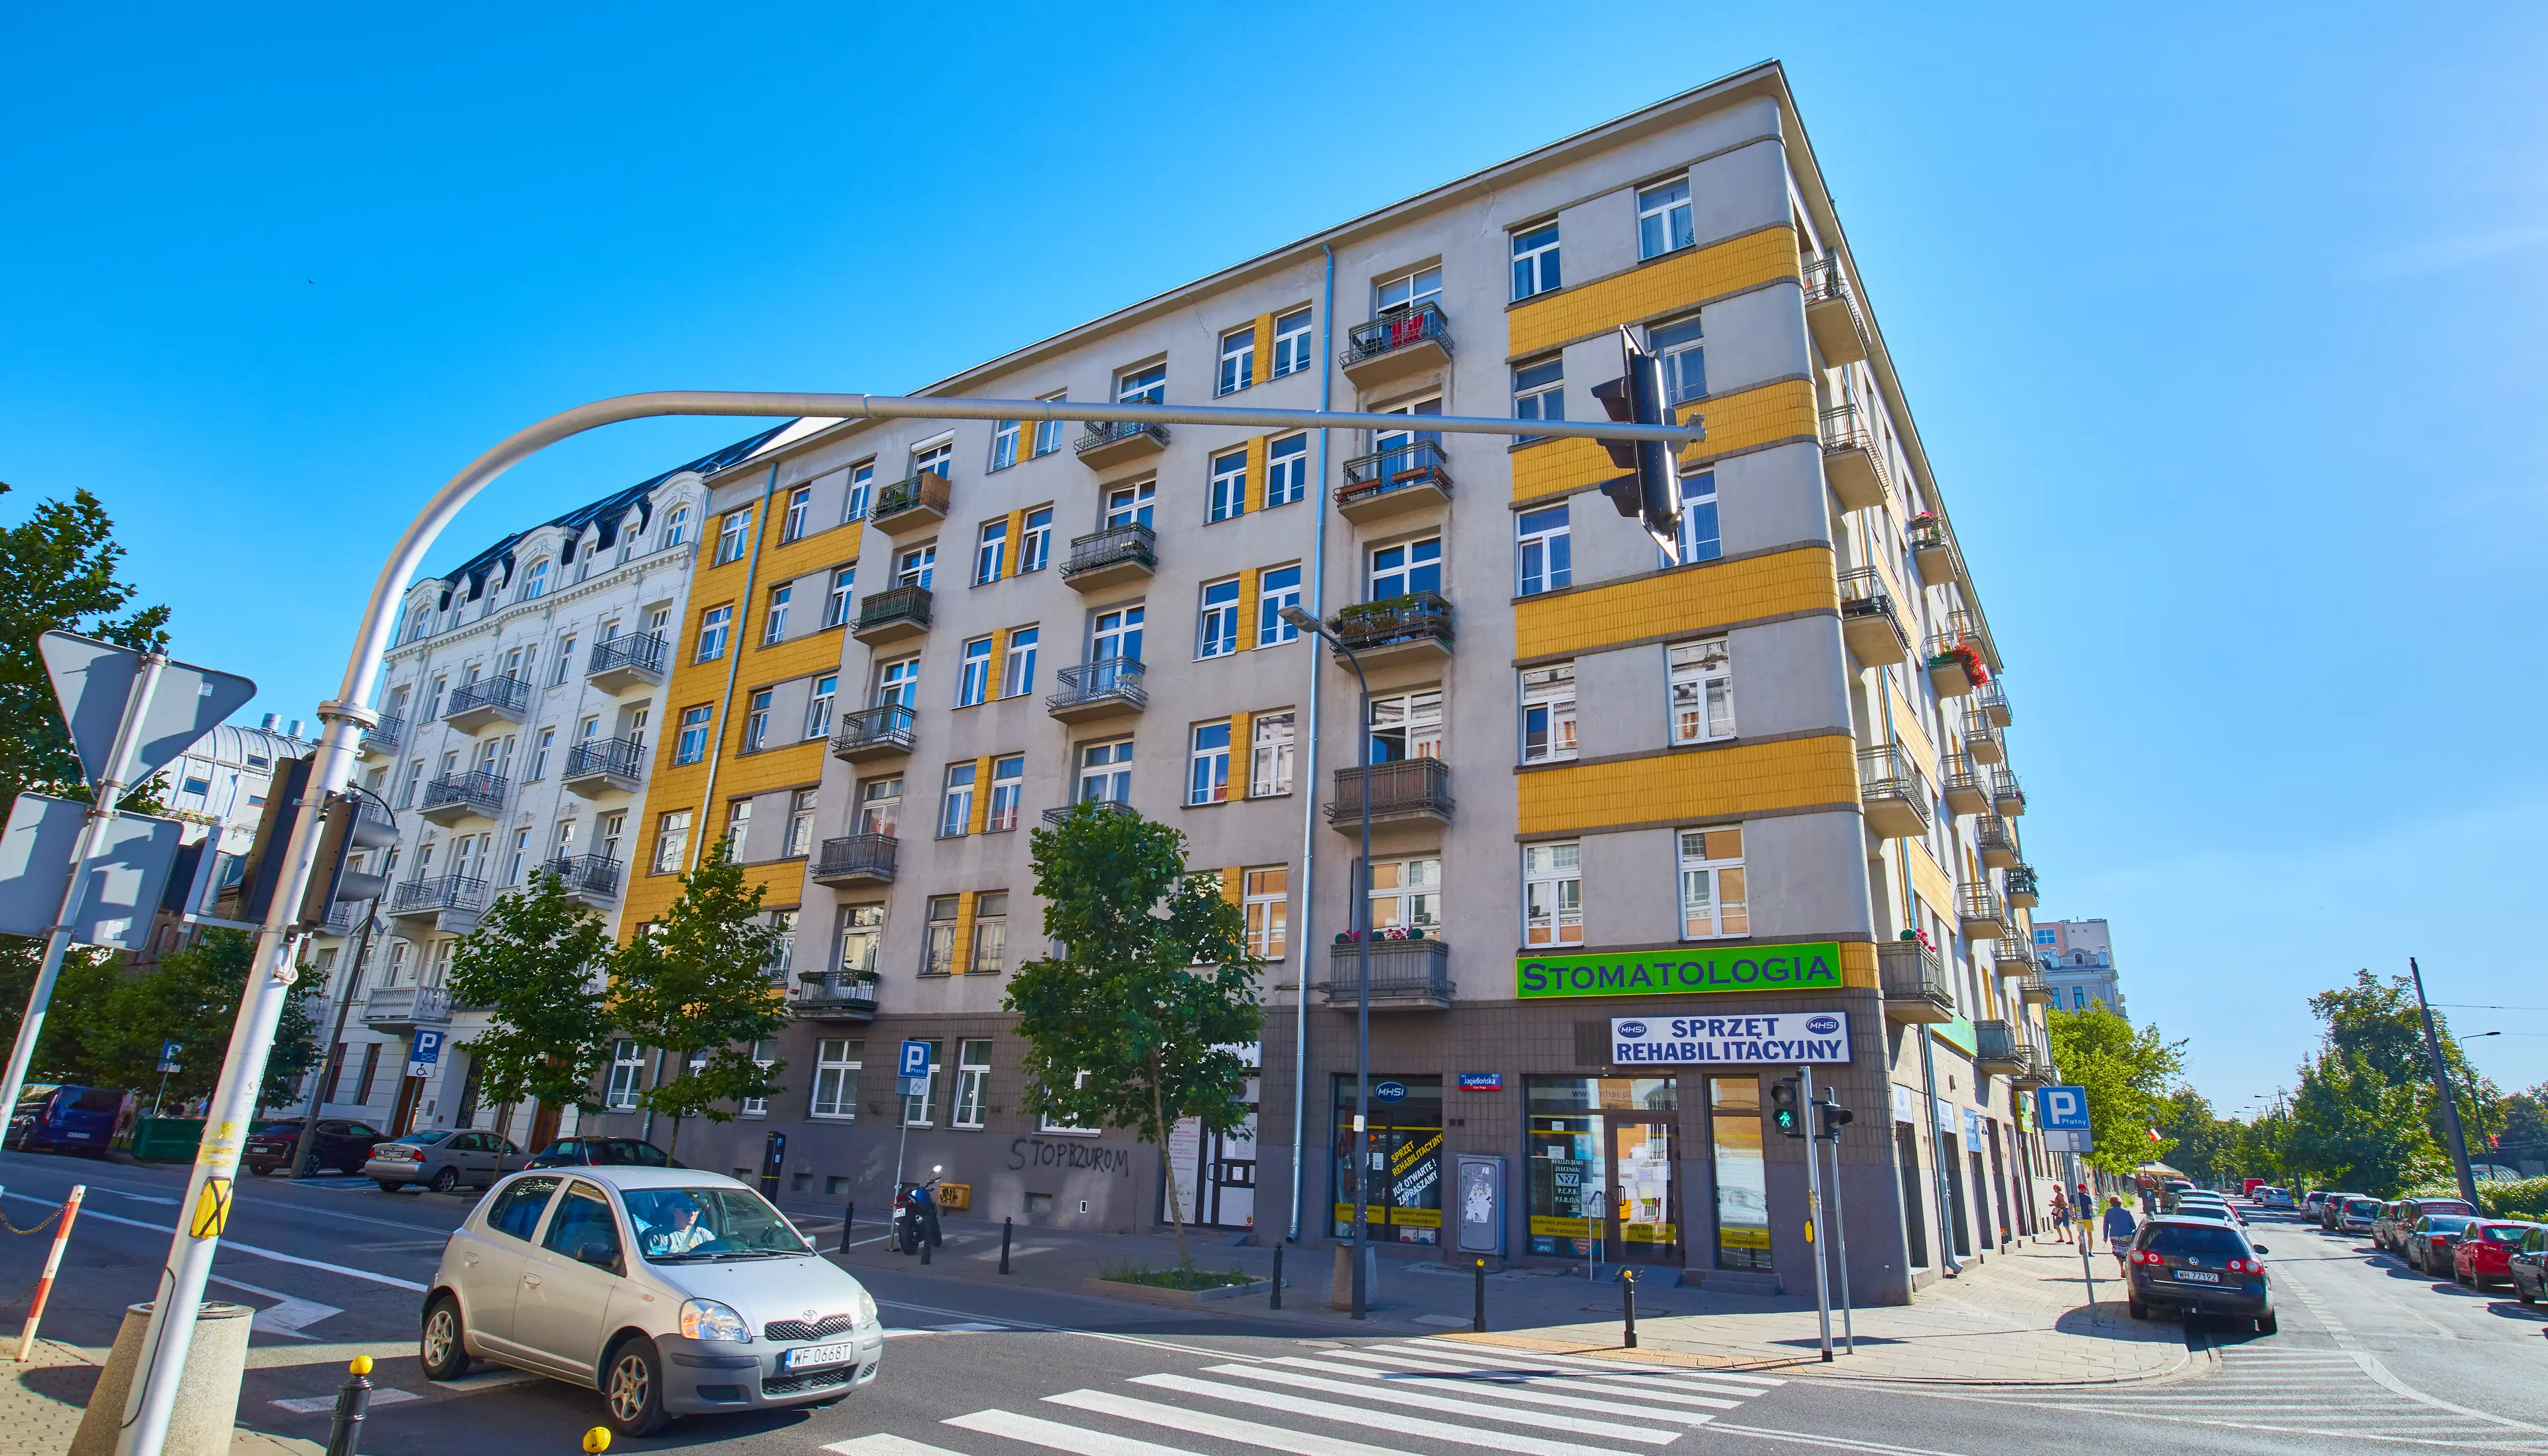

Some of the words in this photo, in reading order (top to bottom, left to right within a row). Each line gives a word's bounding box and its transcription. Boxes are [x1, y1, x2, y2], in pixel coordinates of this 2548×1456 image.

[1523, 955, 1835, 991] STOMATOLOGIA
[1620, 1024, 1646, 1034] MHSI
[1671, 1018, 1779, 1039] SPRZĘT
[1808, 1020, 1837, 1030] MHSI
[419, 1033, 437, 1053] P
[1617, 1039, 1842, 1061] REHABILITACYJNY
[906, 1045, 924, 1073] P
[1378, 1087, 1404, 1096] MHSI
[1464, 1077, 1496, 1086] Jagiellońska
[2048, 1092, 2077, 1124] P
[1391, 1140, 1415, 1163] SPRZĘT
[1391, 1133, 1443, 1177] REHABILITACYJNY
[1393, 1181, 1405, 1197] JUŻ
[1403, 1162, 1433, 1187] OTWARTE
[1397, 1170, 1438, 1206] ZAPRASZAMY
[1557, 1174, 1578, 1184] NFZ
[2192, 1272, 2217, 1281] 77192
[794, 1349, 810, 1365] WF
[814, 1345, 849, 1362] 0668T
